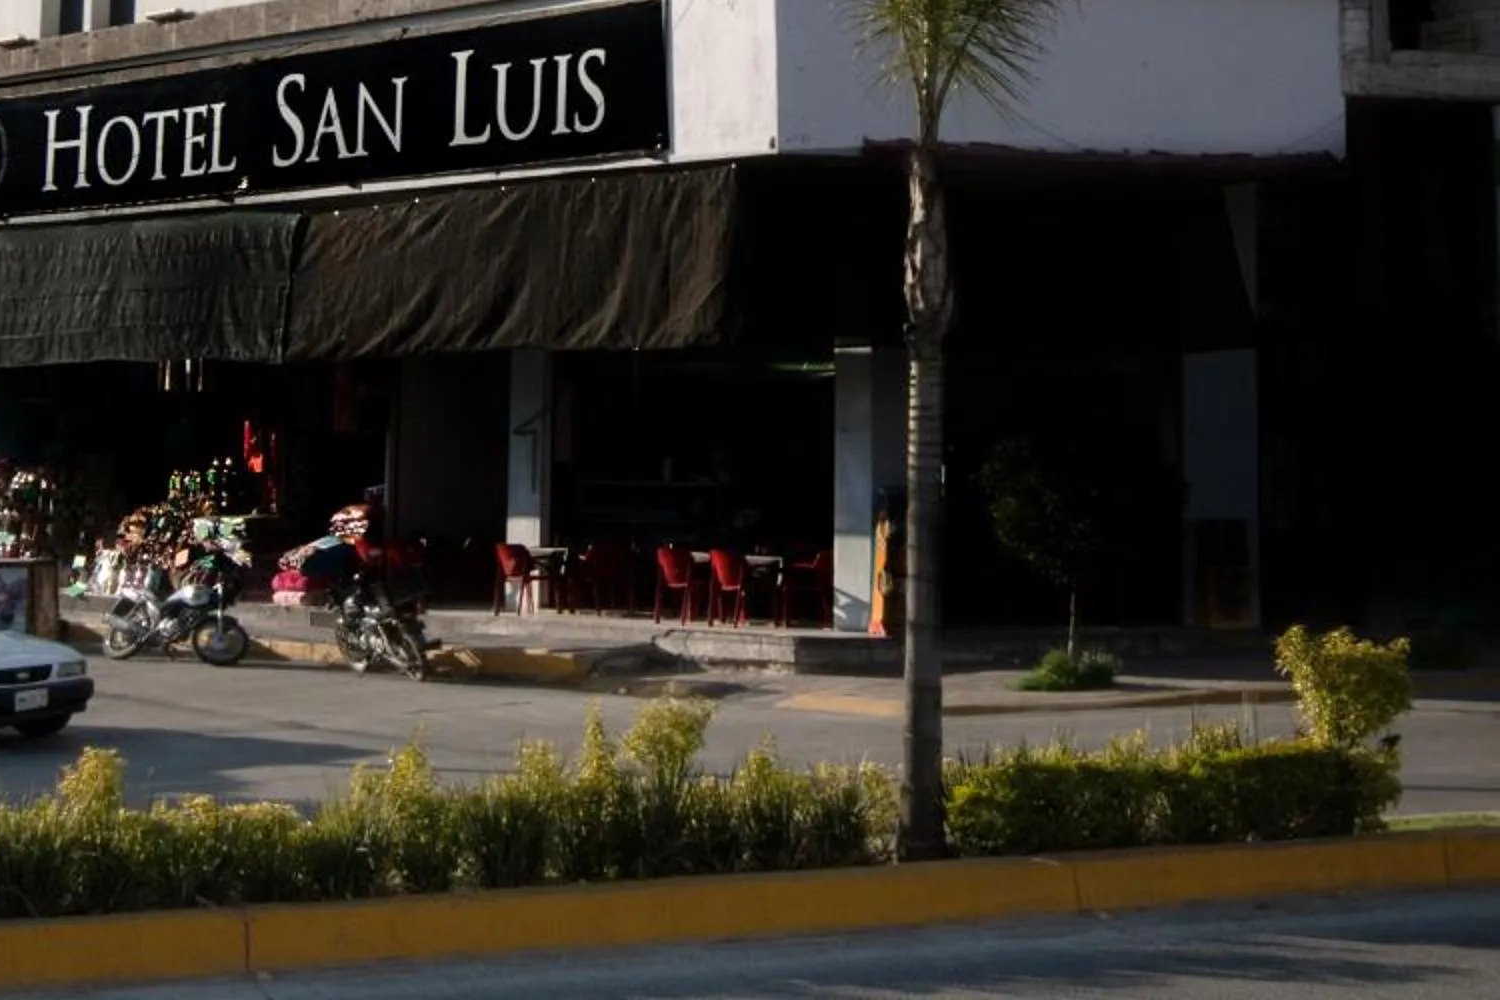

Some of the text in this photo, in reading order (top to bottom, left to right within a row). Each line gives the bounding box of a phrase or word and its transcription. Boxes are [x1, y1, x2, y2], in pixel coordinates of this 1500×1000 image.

[42, 47, 608, 192] HOTEL SAN LUIS
